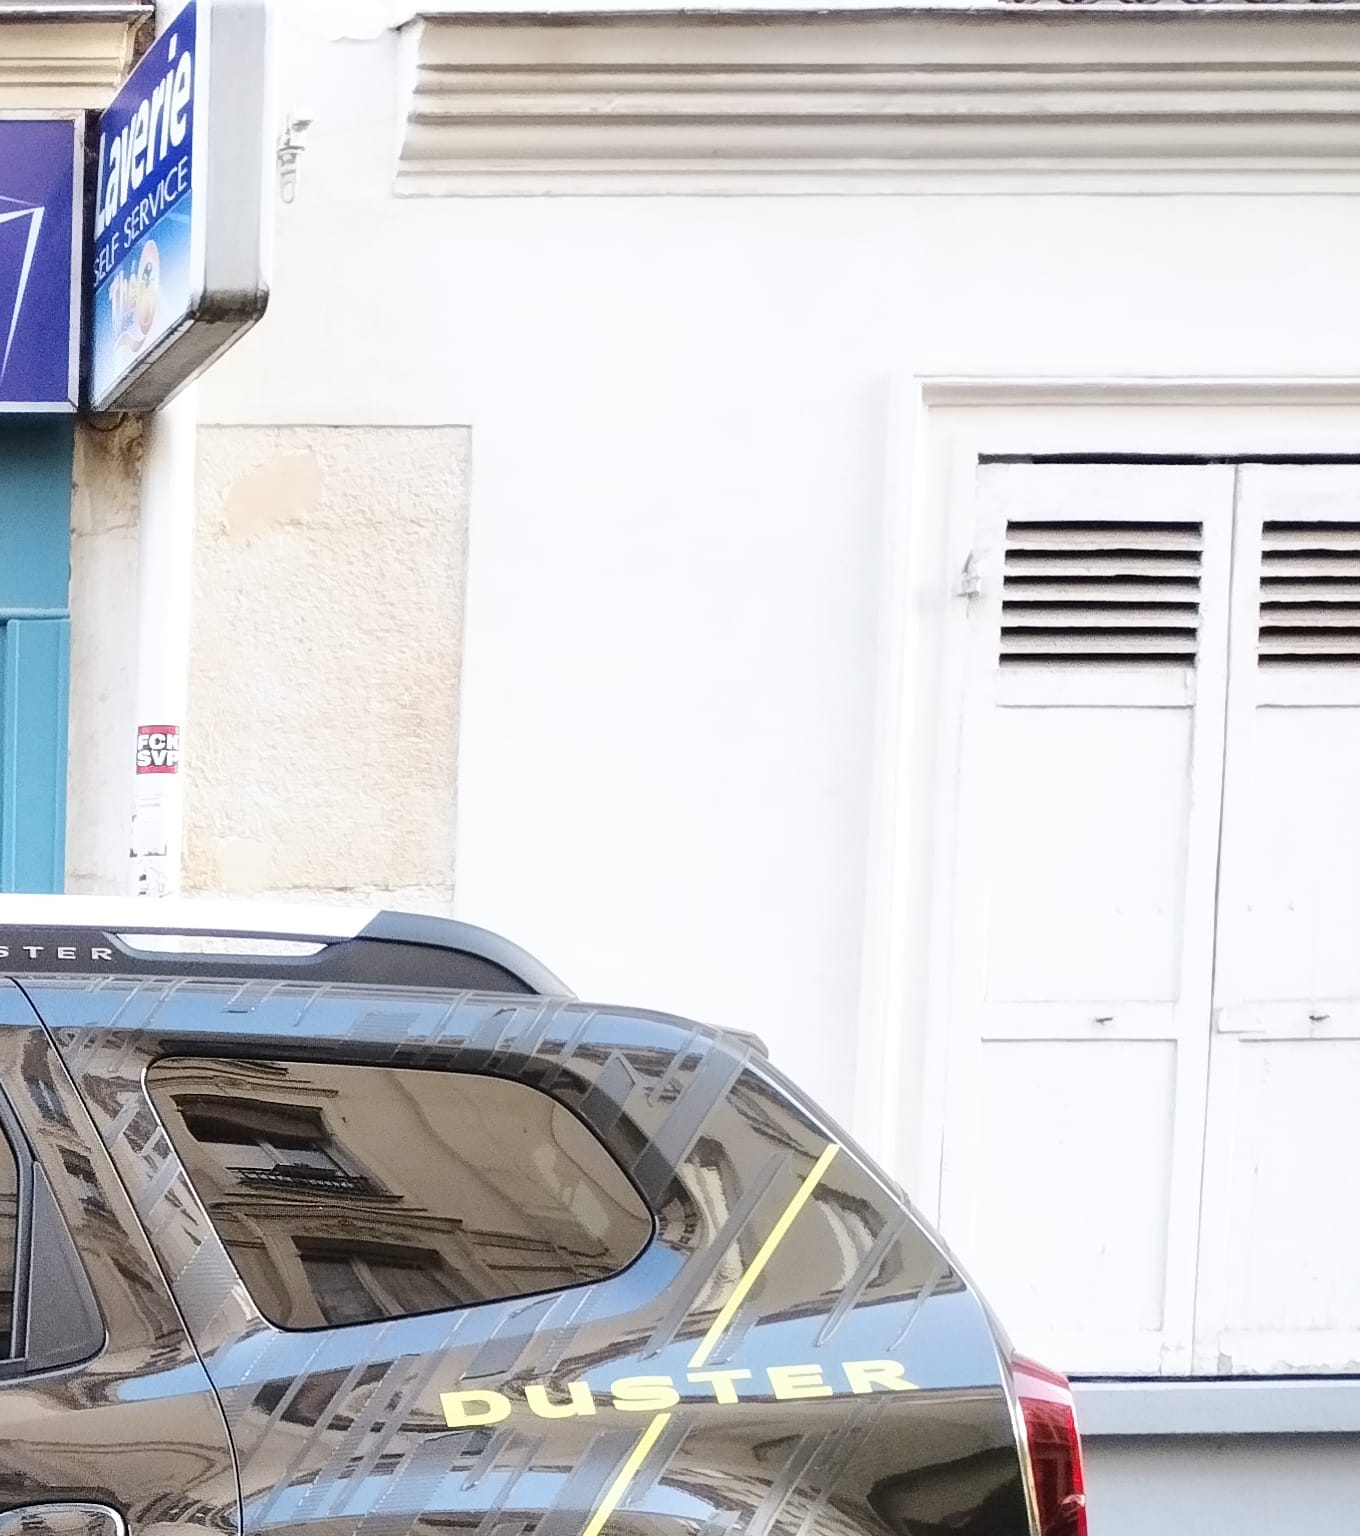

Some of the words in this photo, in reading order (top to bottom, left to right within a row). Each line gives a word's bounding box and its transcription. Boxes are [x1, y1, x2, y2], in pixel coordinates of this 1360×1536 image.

[94, 33, 192, 241] Laverie
[93, 232, 120, 288] SELF
[123, 155, 188, 249] SERVICE
[439, 1360, 919, 1428] DUSTER
